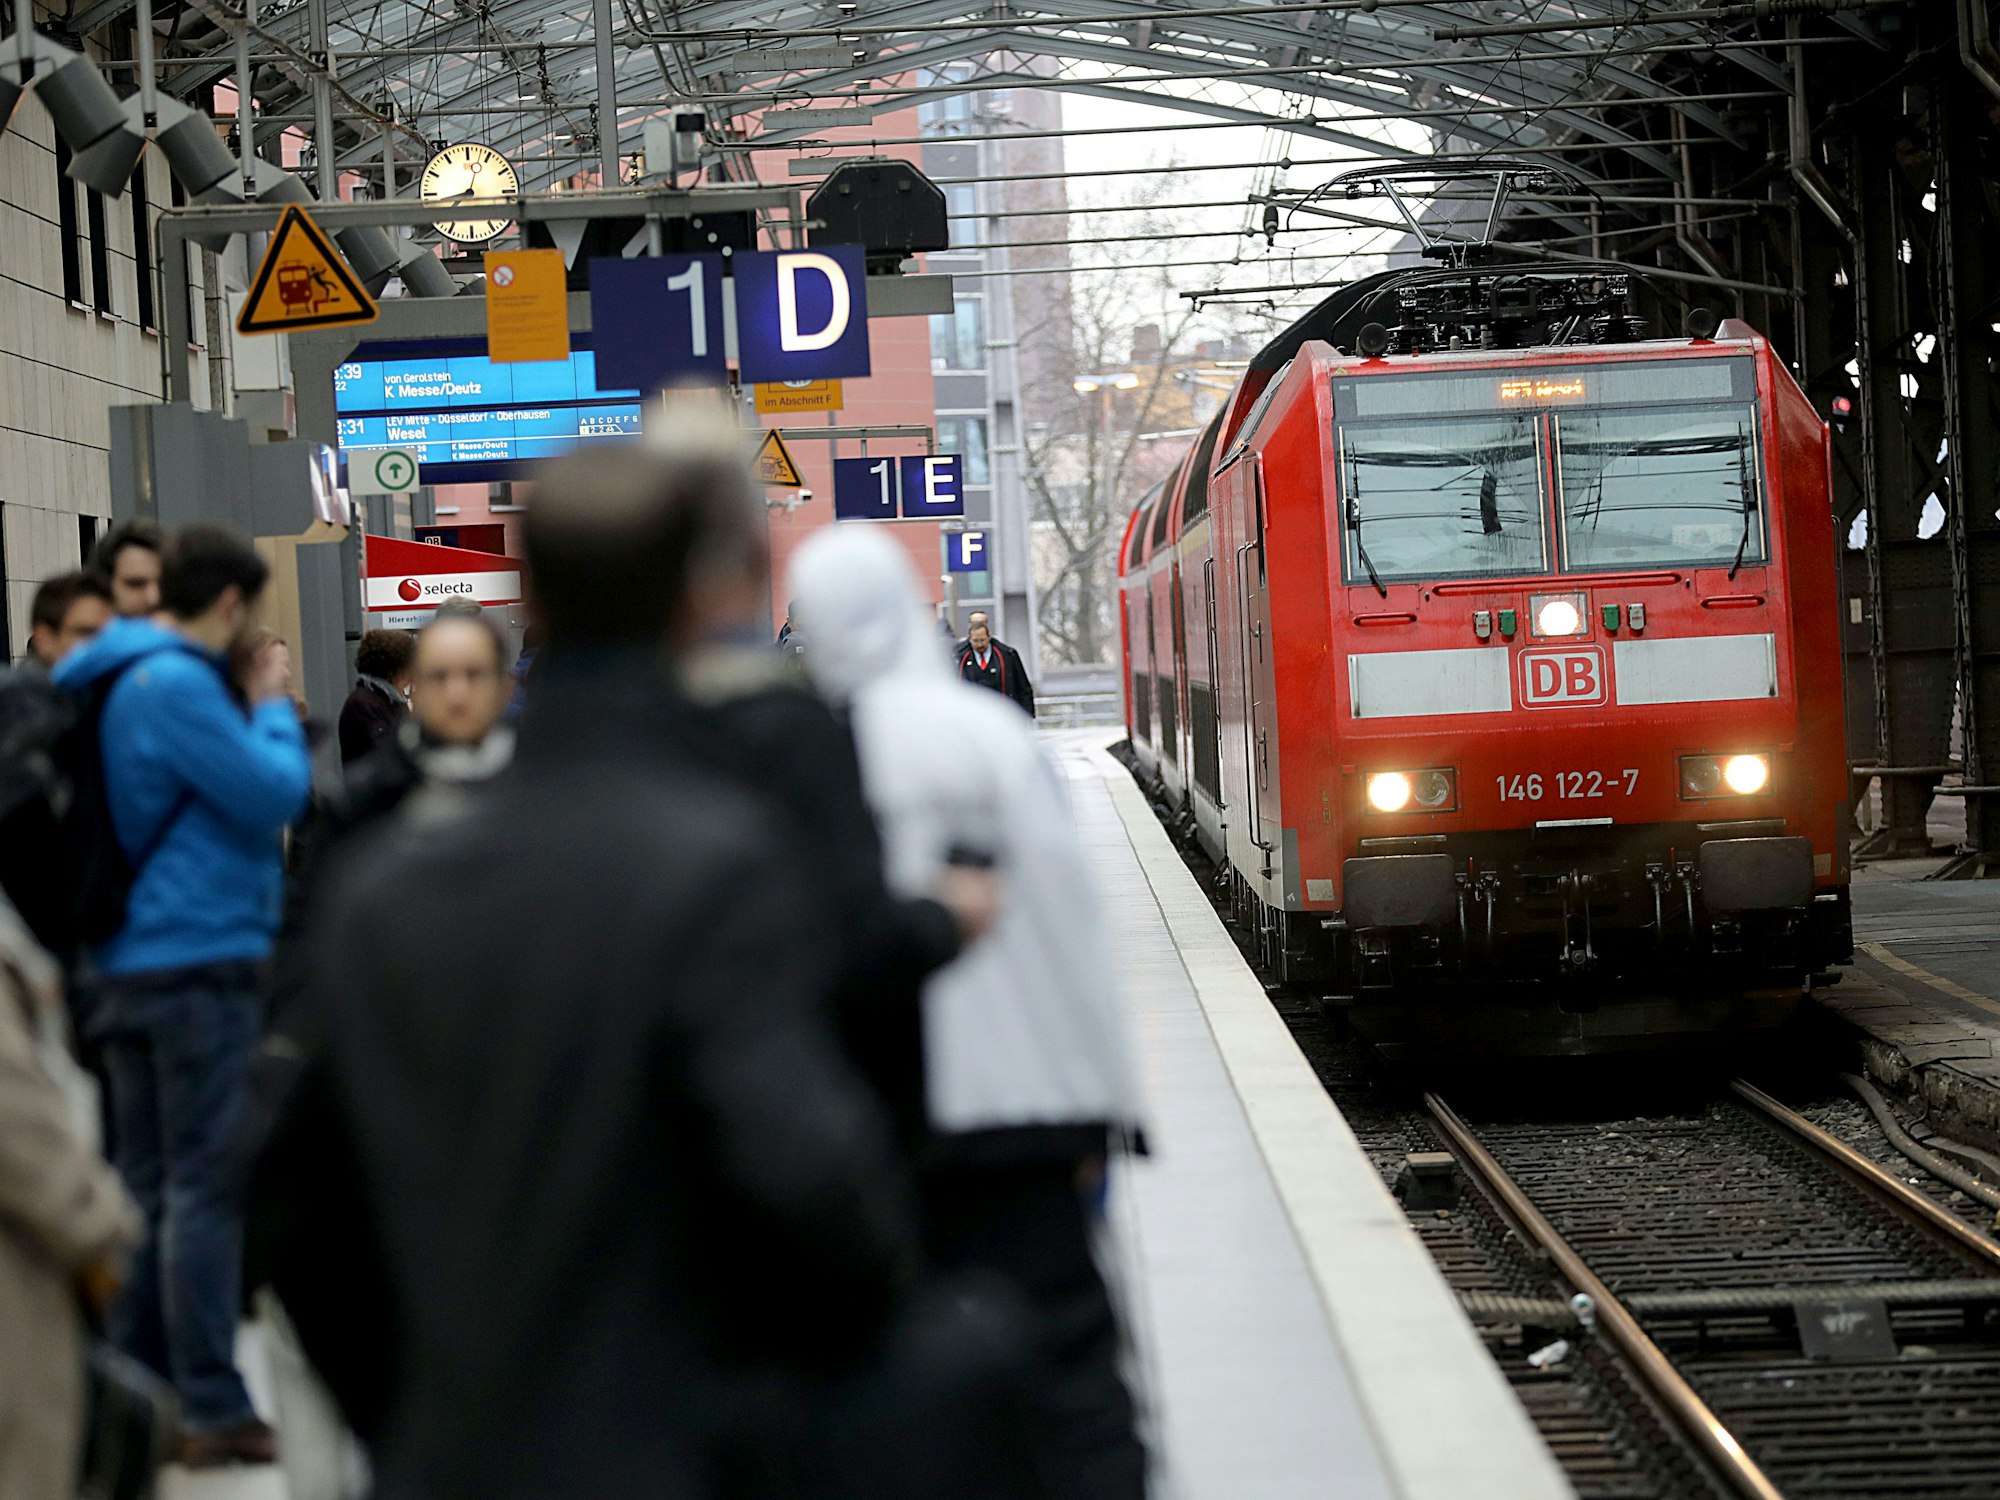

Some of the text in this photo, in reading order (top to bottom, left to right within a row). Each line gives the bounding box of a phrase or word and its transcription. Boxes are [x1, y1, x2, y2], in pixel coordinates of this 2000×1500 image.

[667, 261, 708, 357] 1
[776, 252, 851, 352] D
[384, 372, 451, 384] von Gerolstein
[384, 382, 481, 398] K Messe/Deutz
[765, 395, 832, 406] im Abschnitt F
[386, 416, 403, 427] LEV
[405, 415, 430, 426] Mitte
[438, 412, 488, 424] Düsseldorf
[496, 410, 550, 422] Oberhausen
[387, 427, 427, 440] Wesel
[458, 441, 508, 450] Messe/Deutz
[458, 451, 509, 460] Messe/Deutz
[870, 456, 957, 505] 1 E
[961, 532, 984, 565] F
[424, 581, 473, 595] selecta
[388, 616, 405, 624] Hier
[1530, 657, 1597, 698] DB
[1495, 768, 1639, 802] 146 122-7
